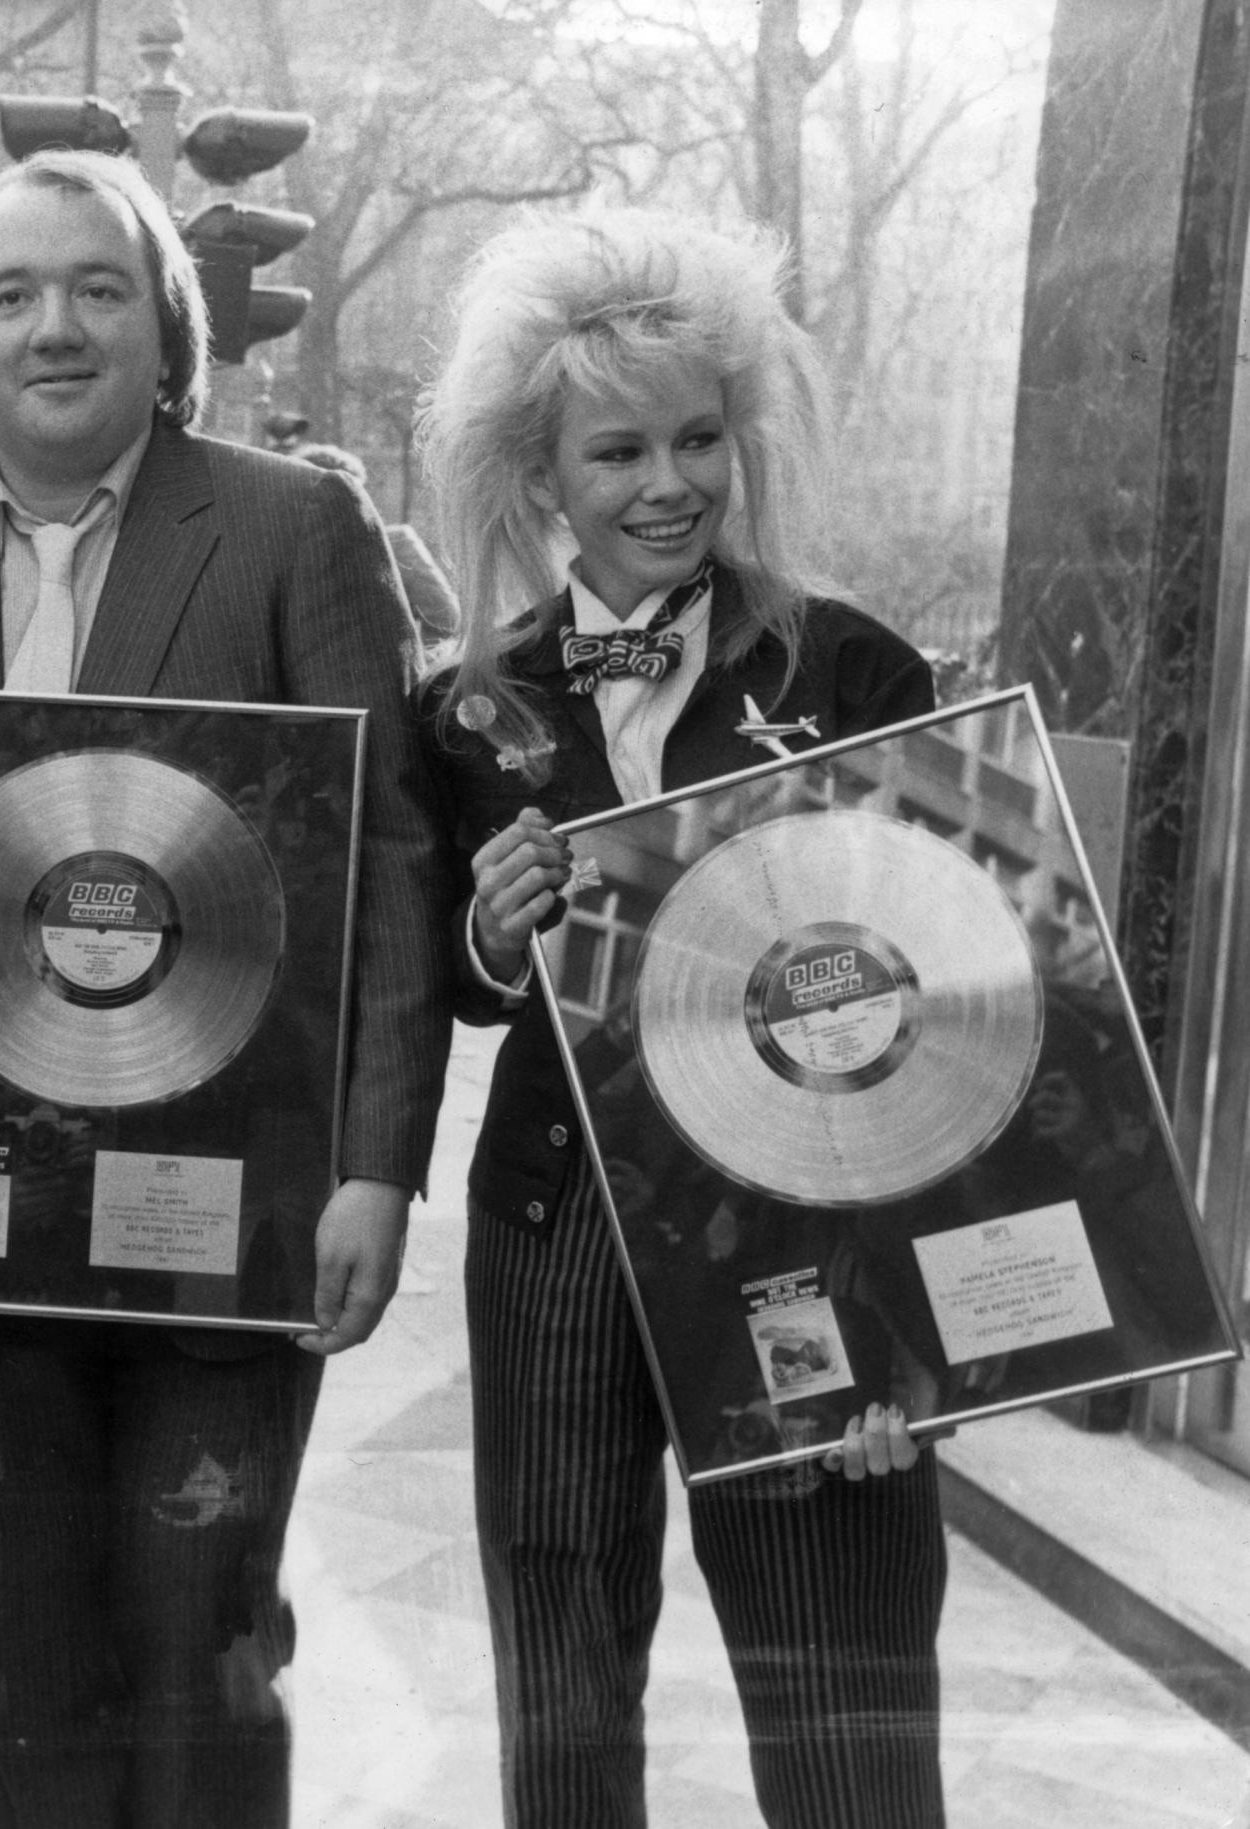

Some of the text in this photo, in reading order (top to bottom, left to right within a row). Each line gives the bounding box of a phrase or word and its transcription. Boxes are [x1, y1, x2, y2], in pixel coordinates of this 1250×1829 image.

[69, 882, 137, 904] BBC
[70, 904, 136, 920] records
[787, 951, 855, 989] BBC
[793, 974, 861, 1004] records
[959, 1254, 1056, 1285] PAMELA STEPHENSON
